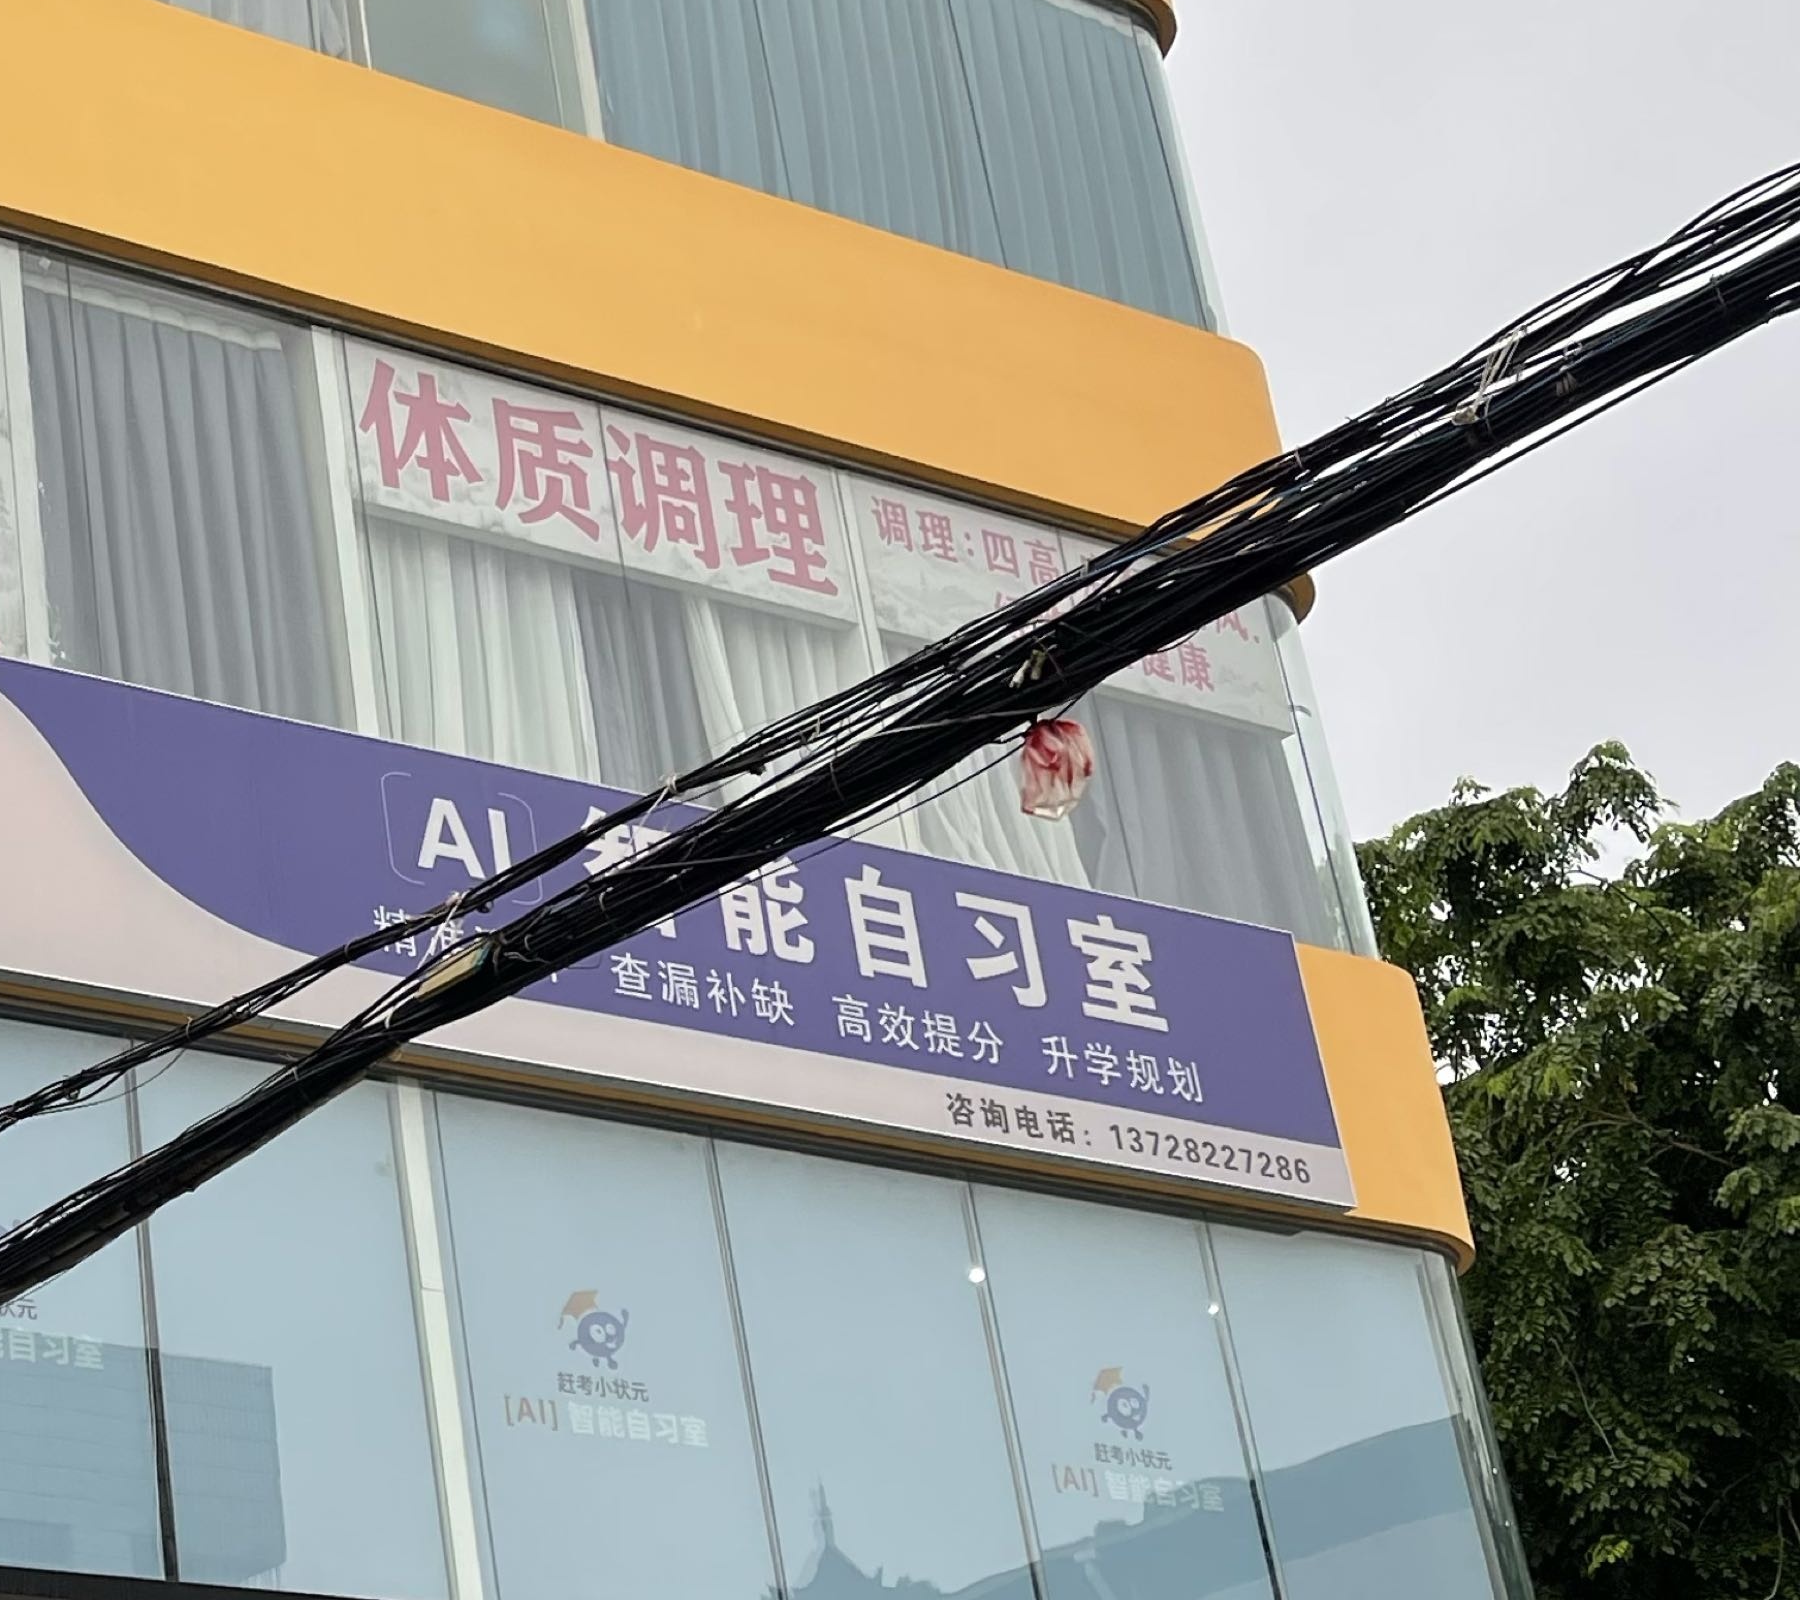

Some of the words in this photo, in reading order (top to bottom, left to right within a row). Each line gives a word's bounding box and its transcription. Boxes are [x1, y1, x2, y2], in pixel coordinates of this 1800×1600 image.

[359, 357, 839, 599] 体质调理
[609, 950, 796, 1027] 查漏补缺
[830, 993, 1005, 1065] 高效提分
[1040, 1034, 1204, 1104] 升学规划
[1109, 1123, 1312, 1184] 13728227286
[557, 1371, 650, 1402] 赶考小状元
[568, 1401, 709, 1447] 智能自习室
